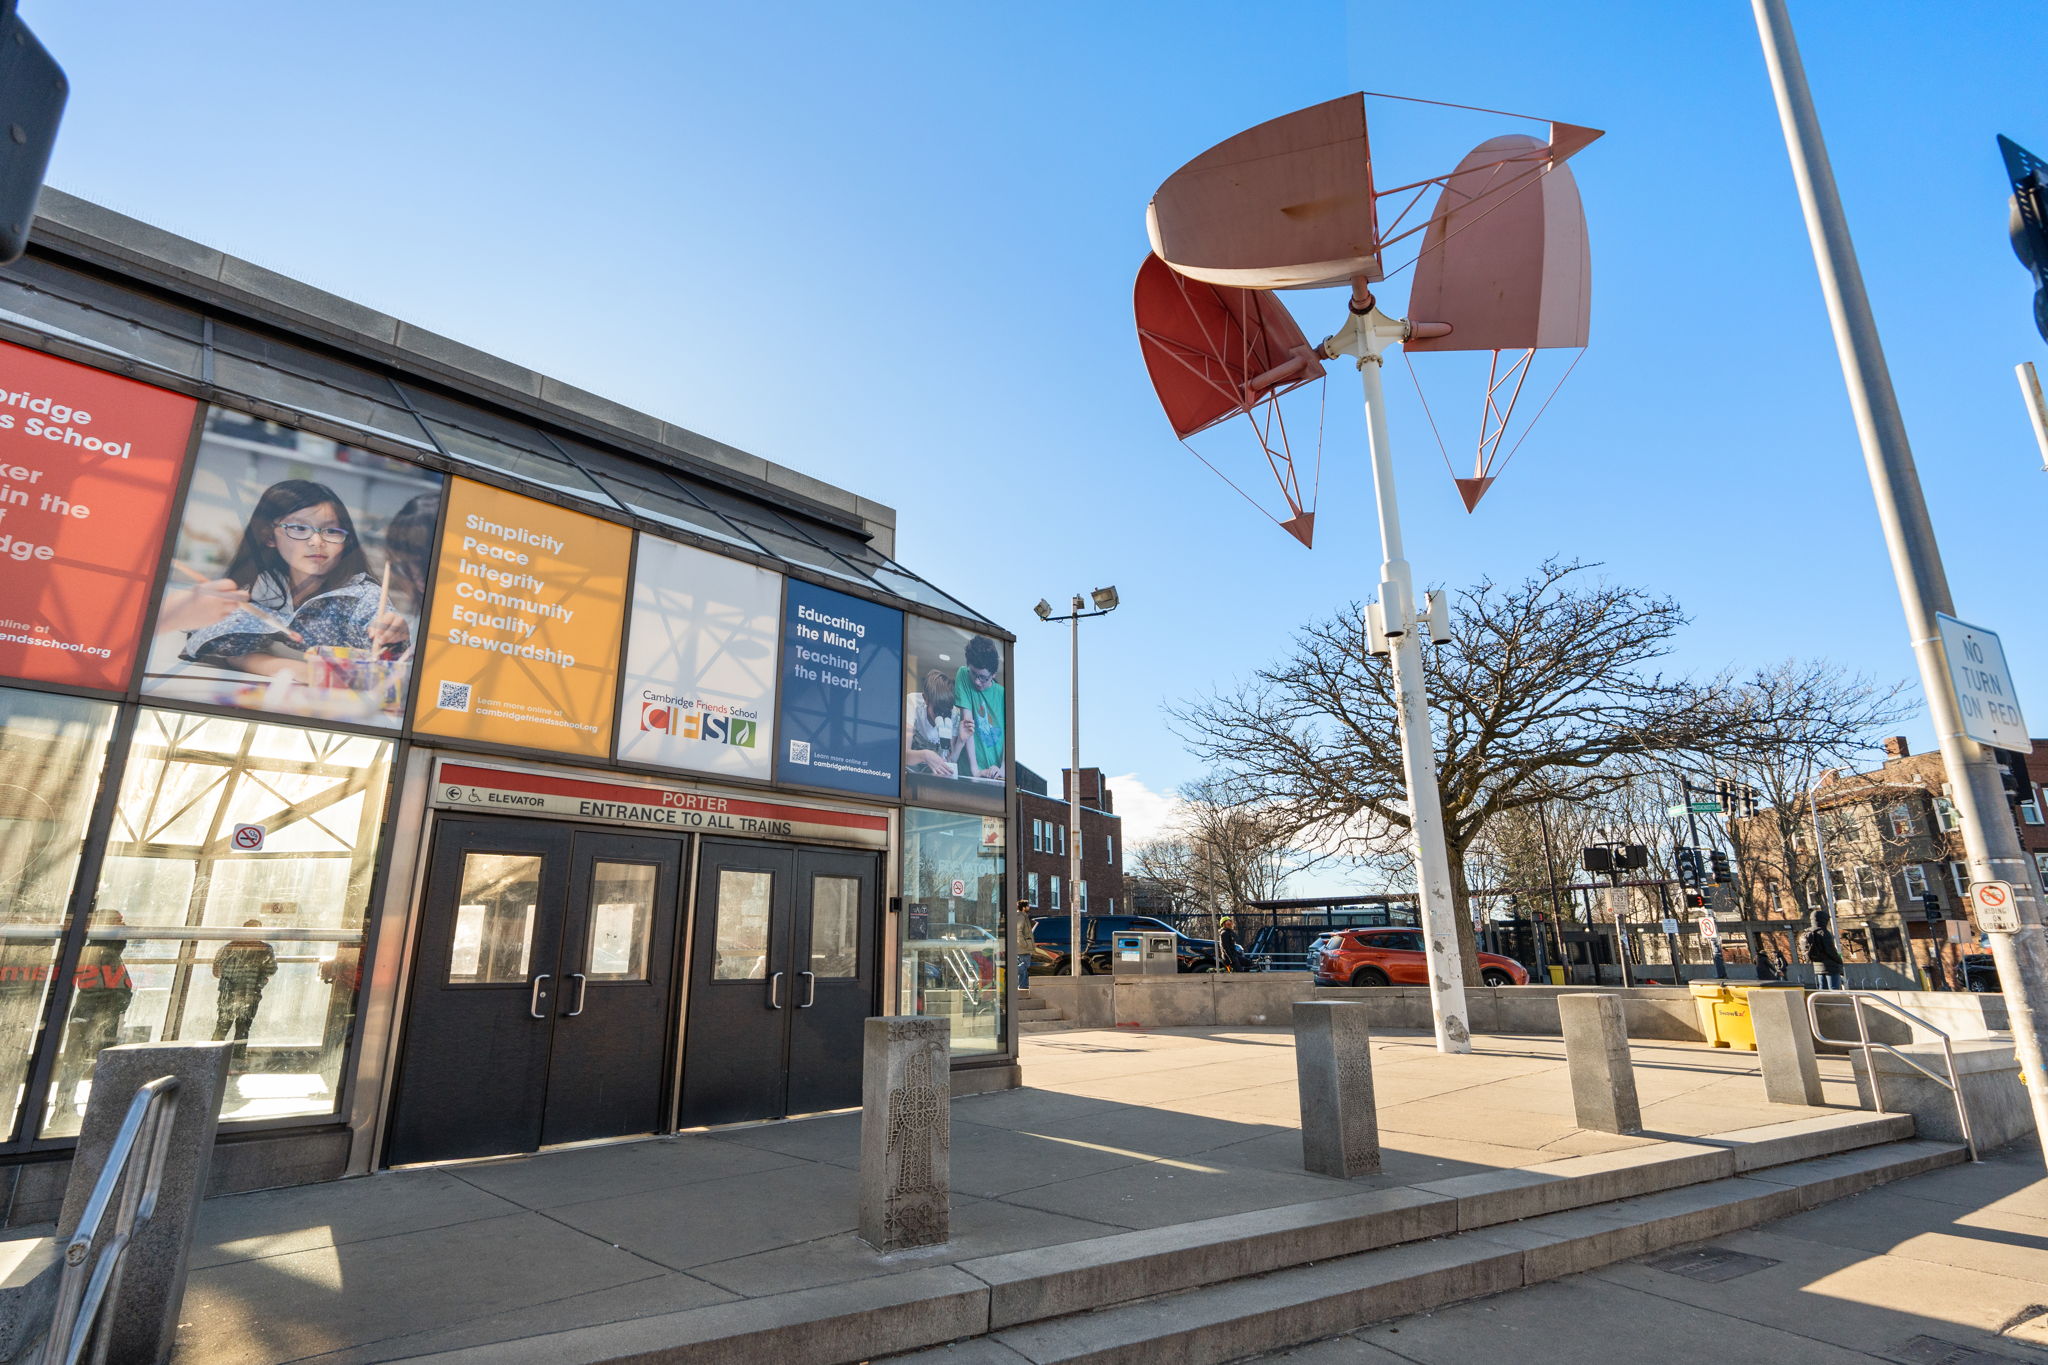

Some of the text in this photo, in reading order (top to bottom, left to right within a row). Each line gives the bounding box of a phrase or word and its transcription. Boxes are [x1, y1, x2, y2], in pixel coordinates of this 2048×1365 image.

[24, 417, 132, 459] School
[0, 484, 91, 519] in the
[465, 513, 564, 555] Simplicity
[463, 536, 529, 565] Peace
[459, 558, 545, 594] Integrity
[455, 582, 574, 624] Community
[34, 625, 50, 634] at
[452, 604, 537, 639] Equality
[798, 605, 865, 638] Educating
[0, 632, 112, 659] endsschool.org
[448, 628, 575, 668] Stewardship
[796, 623, 860, 654] the Mind,
[1962, 639, 1984, 665] NO
[795, 644, 858, 675] Teaching
[794, 664, 862, 692] the Heart.
[1961, 666, 2003, 697] TURN
[477, 696, 564, 718] Learn more online at
[643, 690, 758, 720] Cambridge Friends School
[1962, 693, 2019, 728] ON RED
[475, 707, 599, 734] cambridgefriendsschool.org
[813, 752, 830, 760] Learn
[845, 758, 862, 766] online
[813, 760, 892, 780] cambridgefriendsschool.org
[488, 793, 545, 807] ELEVATOR
[662, 791, 728, 812] PORTER
[579, 801, 792, 836] ENTRANCE TO ALL TRAINS
[1983, 907, 2007, 915] RIDING
